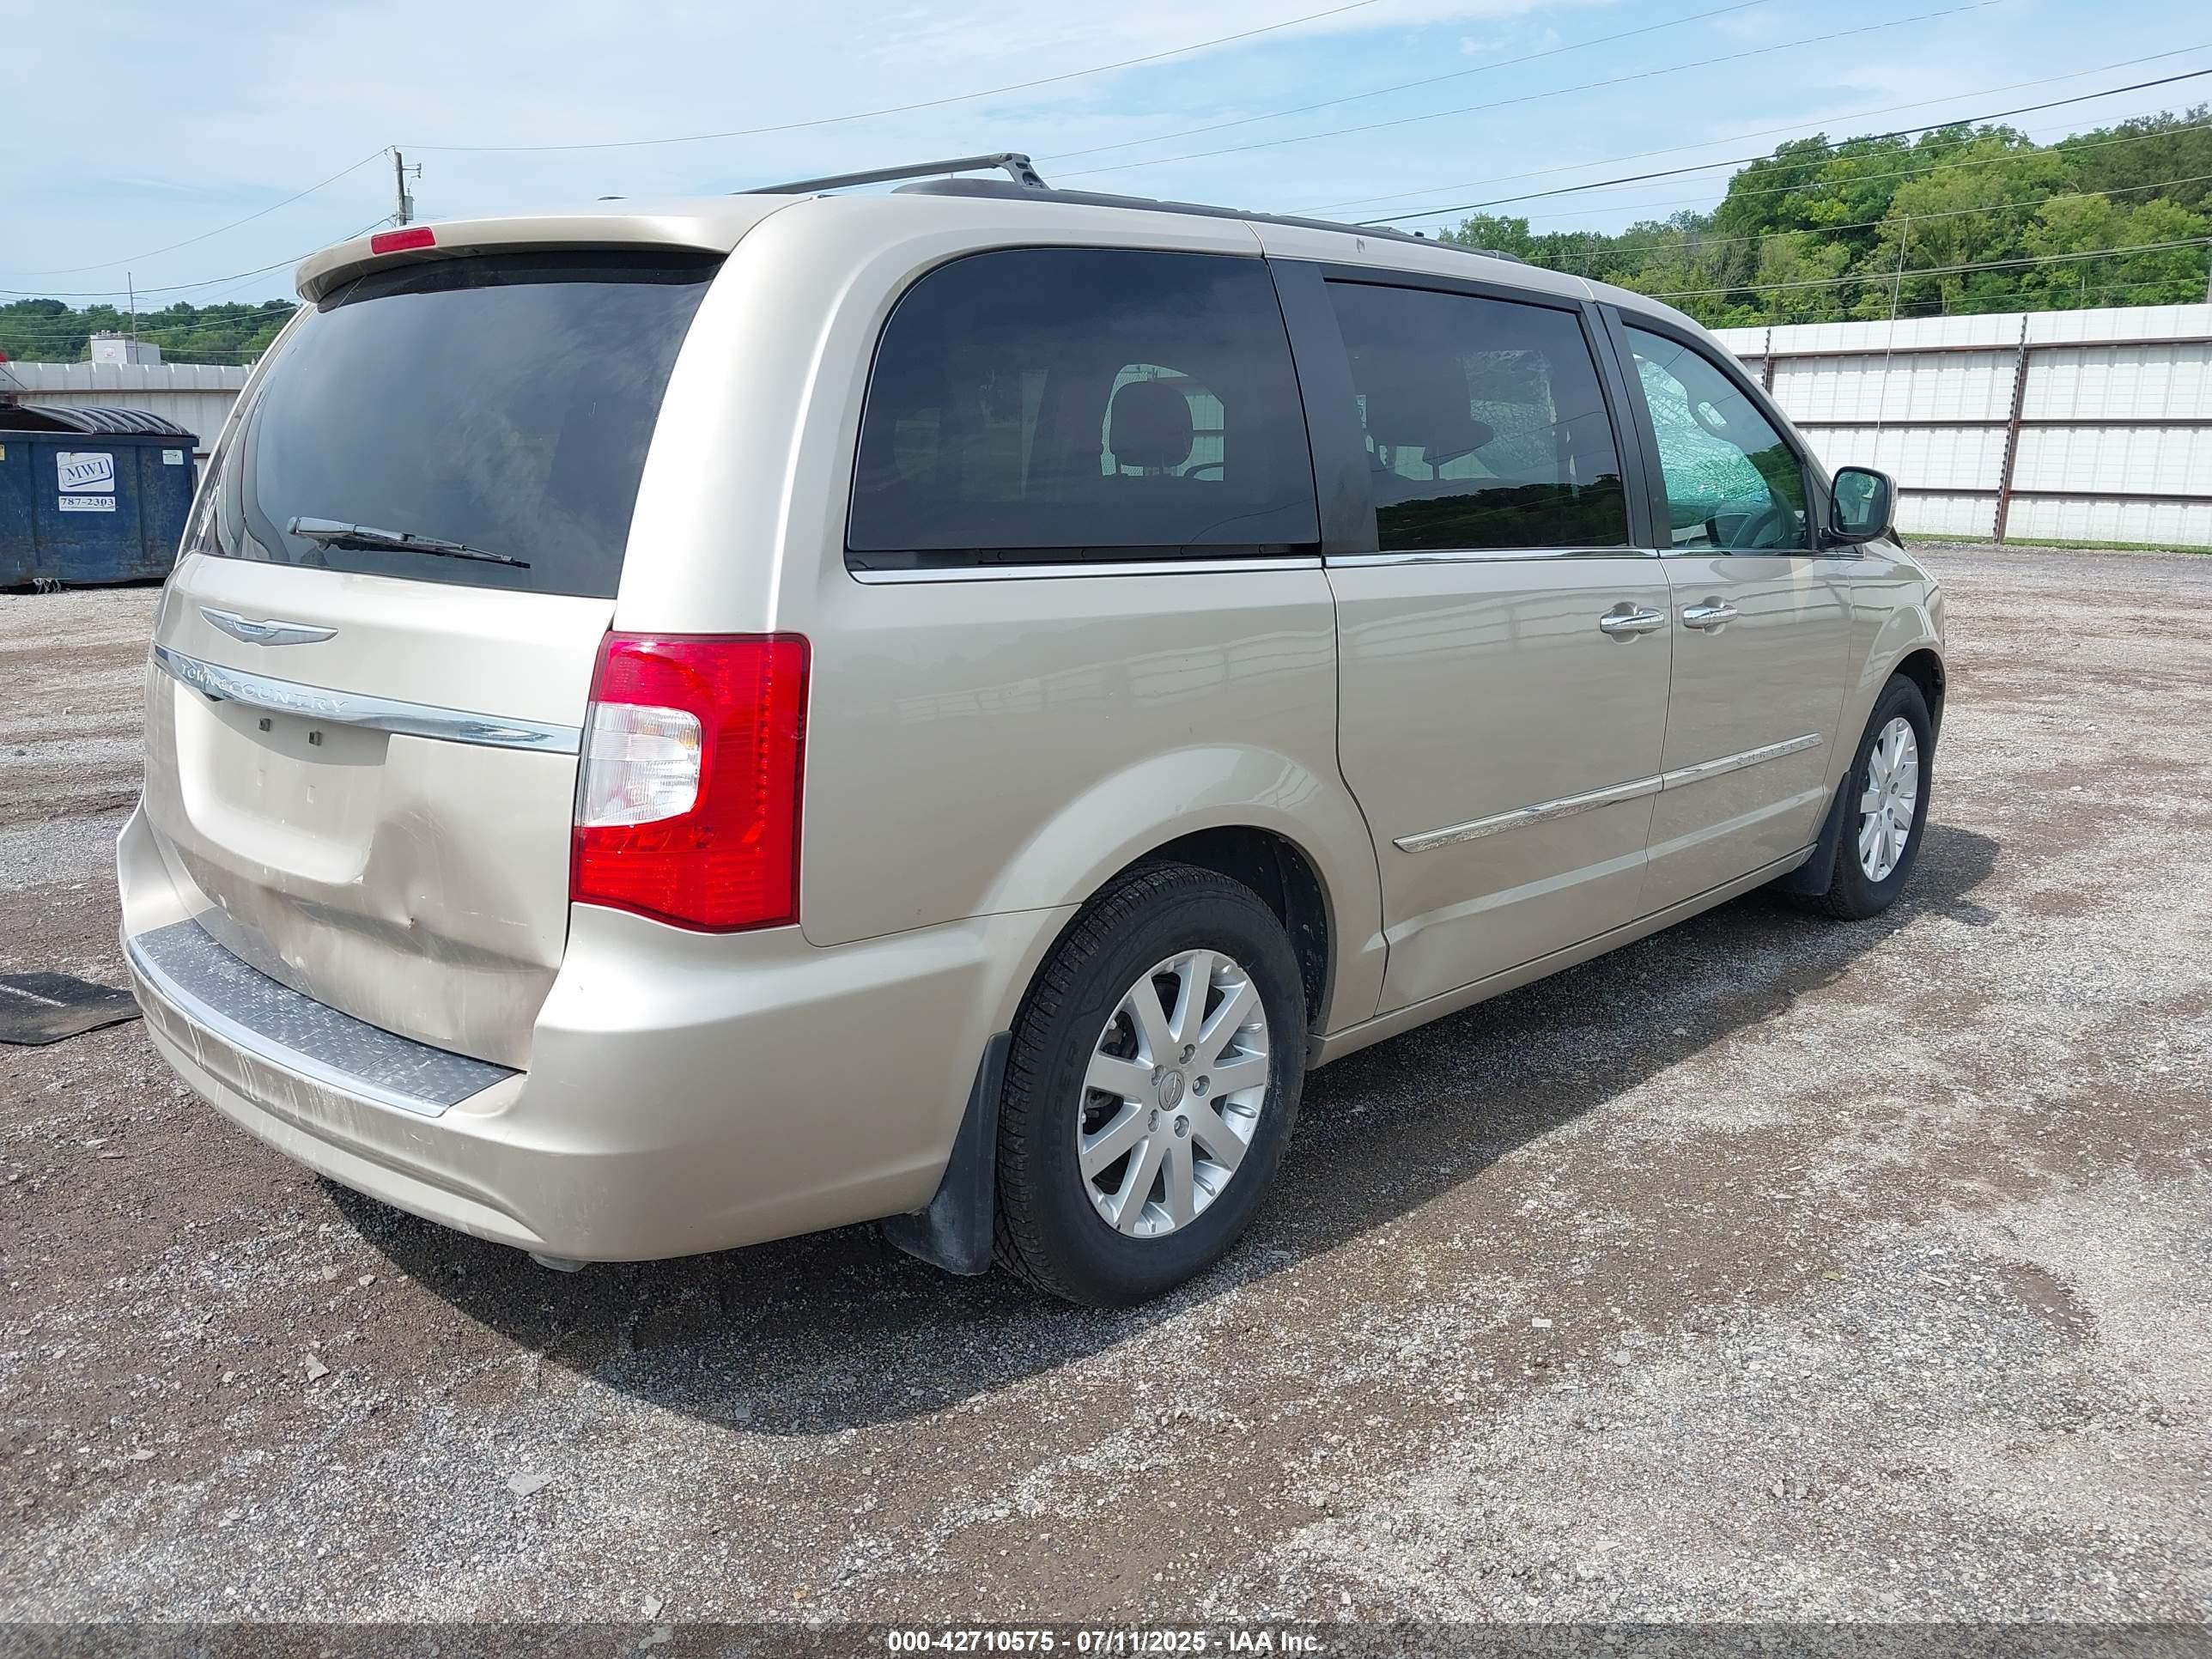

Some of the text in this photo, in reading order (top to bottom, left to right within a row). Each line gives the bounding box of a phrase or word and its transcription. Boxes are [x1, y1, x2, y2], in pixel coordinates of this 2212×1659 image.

[67, 461, 106, 481] MWI
[60, 497, 114, 507] 787-2303
[181, 663, 216, 687] TOWN
[229, 679, 349, 713] COUNTRY
